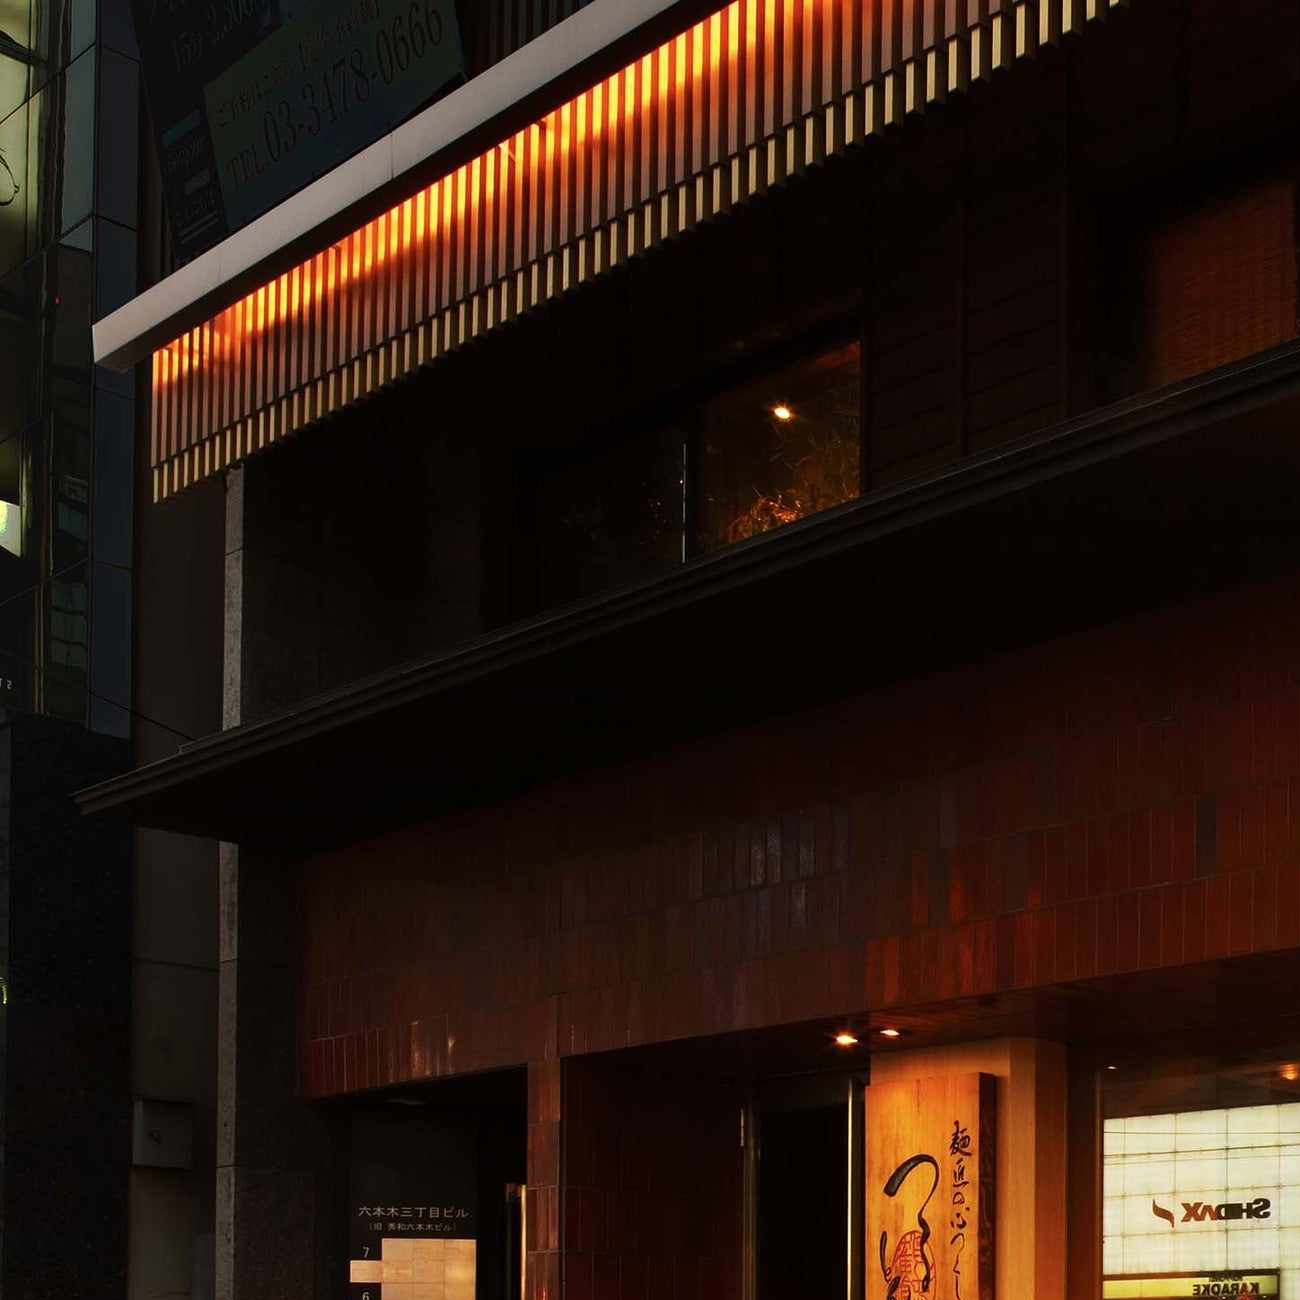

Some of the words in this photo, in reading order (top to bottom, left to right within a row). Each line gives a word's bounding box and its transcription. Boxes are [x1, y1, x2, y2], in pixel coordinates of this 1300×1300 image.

[358, 1205, 471, 1219] 六本木三丁目ビル
[362, 1246, 370, 1259] 7
